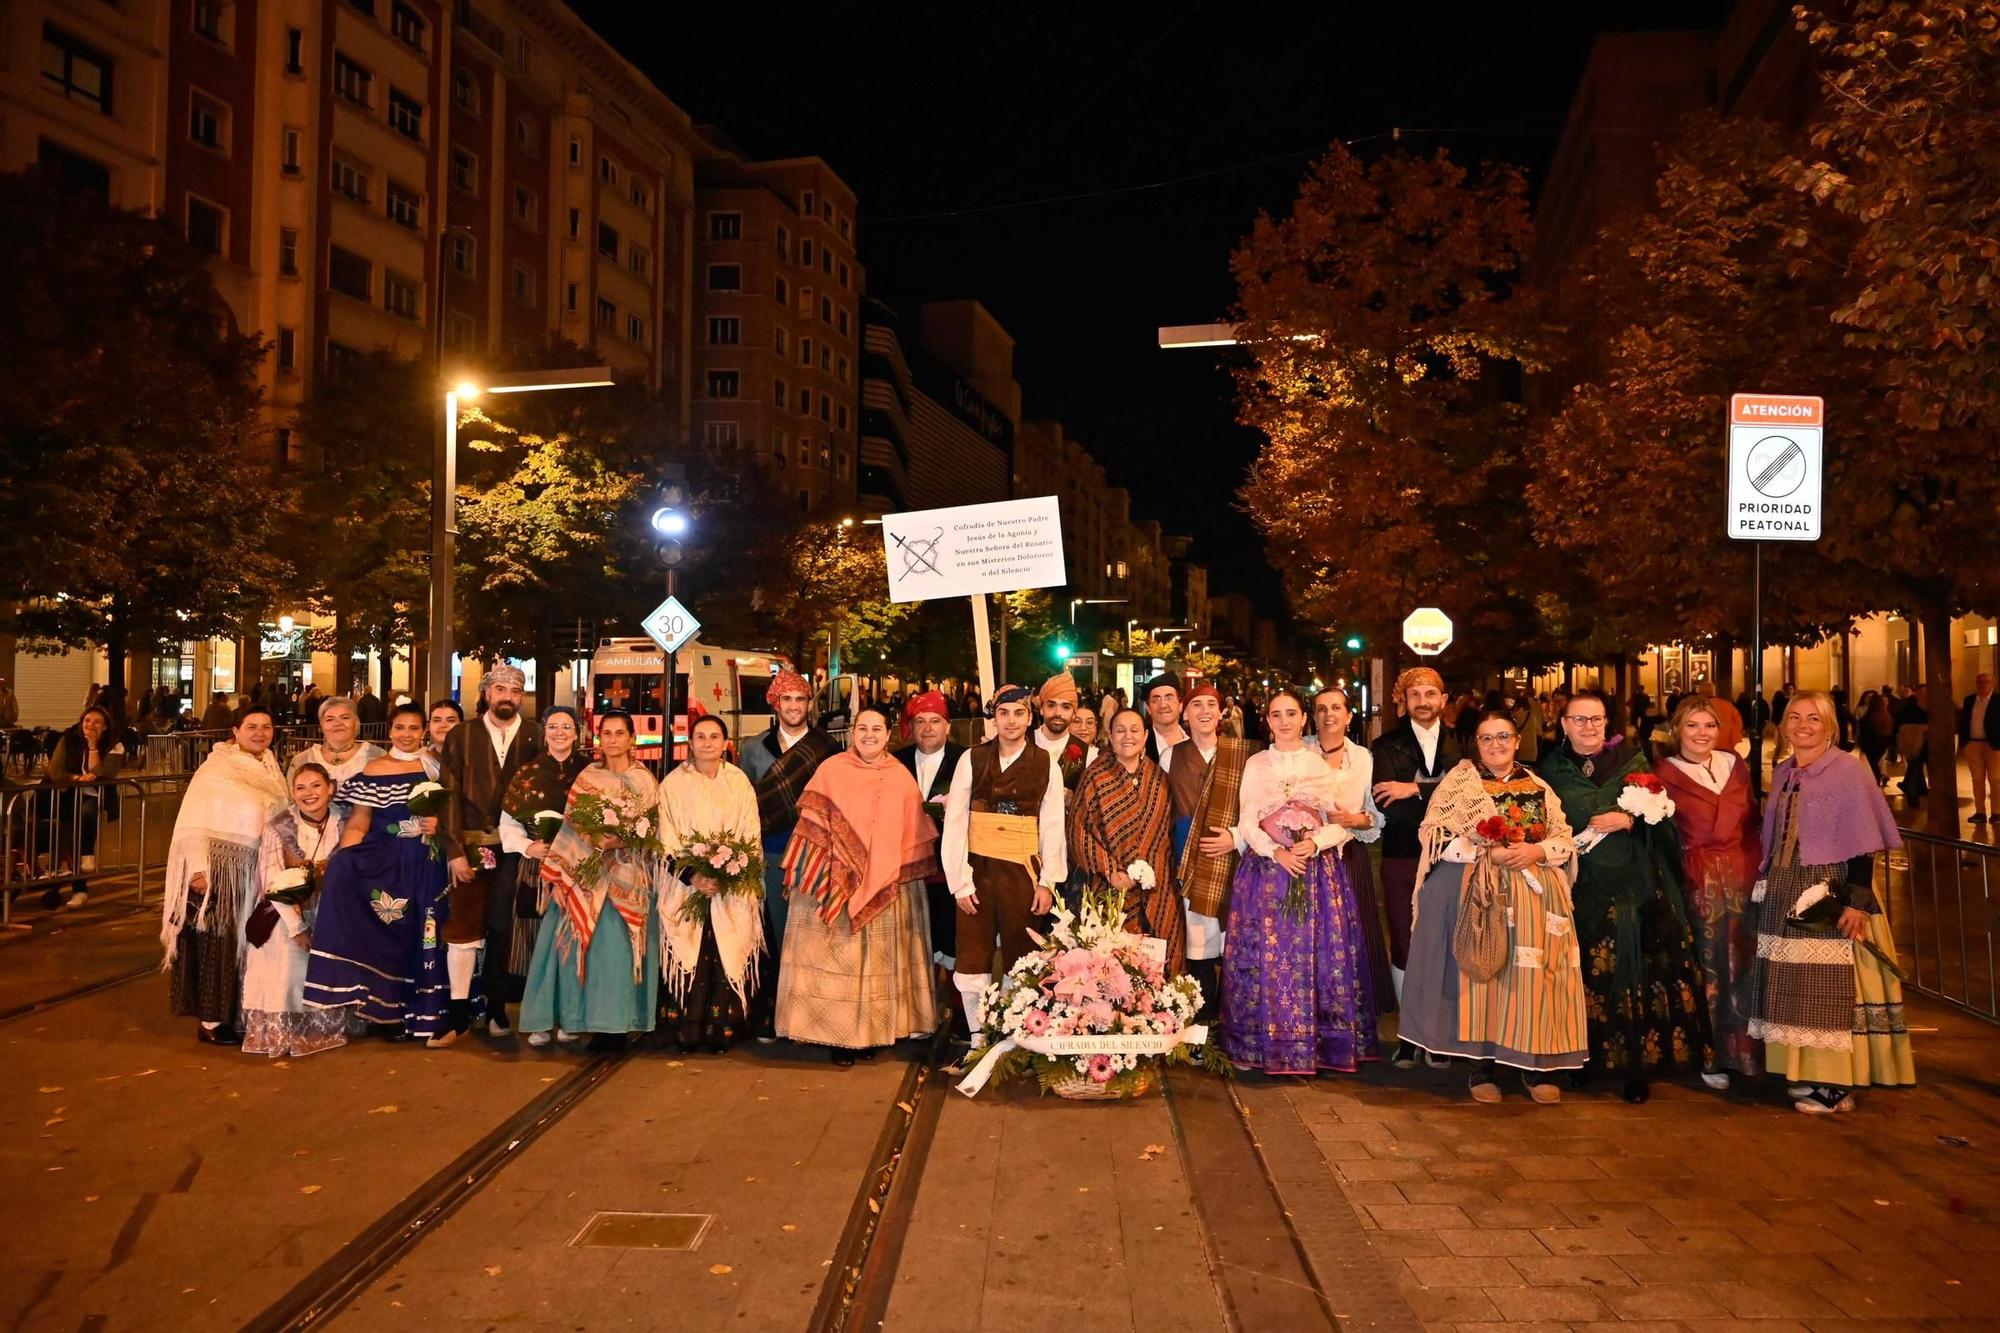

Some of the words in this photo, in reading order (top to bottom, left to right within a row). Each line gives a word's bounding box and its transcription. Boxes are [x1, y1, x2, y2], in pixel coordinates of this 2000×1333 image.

[1742, 404, 1813, 417] ATENCIÓN
[1739, 502, 1812, 514] PRIORIDAD
[997, 518, 1027, 526] Nuestro
[1028, 515, 1049, 523] Padre
[1740, 520, 1810, 531] PEATONAL
[967, 534, 986, 543] Jesús
[955, 548, 984, 556] Nuestra
[1025, 540, 1053, 548] Rosario
[981, 556, 1015, 565] Misterios
[1017, 552, 1053, 560] Dolorosos
[1001, 566, 1031, 575] Silencio
[658, 615, 684, 634] 30
[607, 656, 663, 666] AMBULAN
[1099, 1041, 1117, 1050] DEL
[1121, 1040, 1163, 1049] SILENCIO
